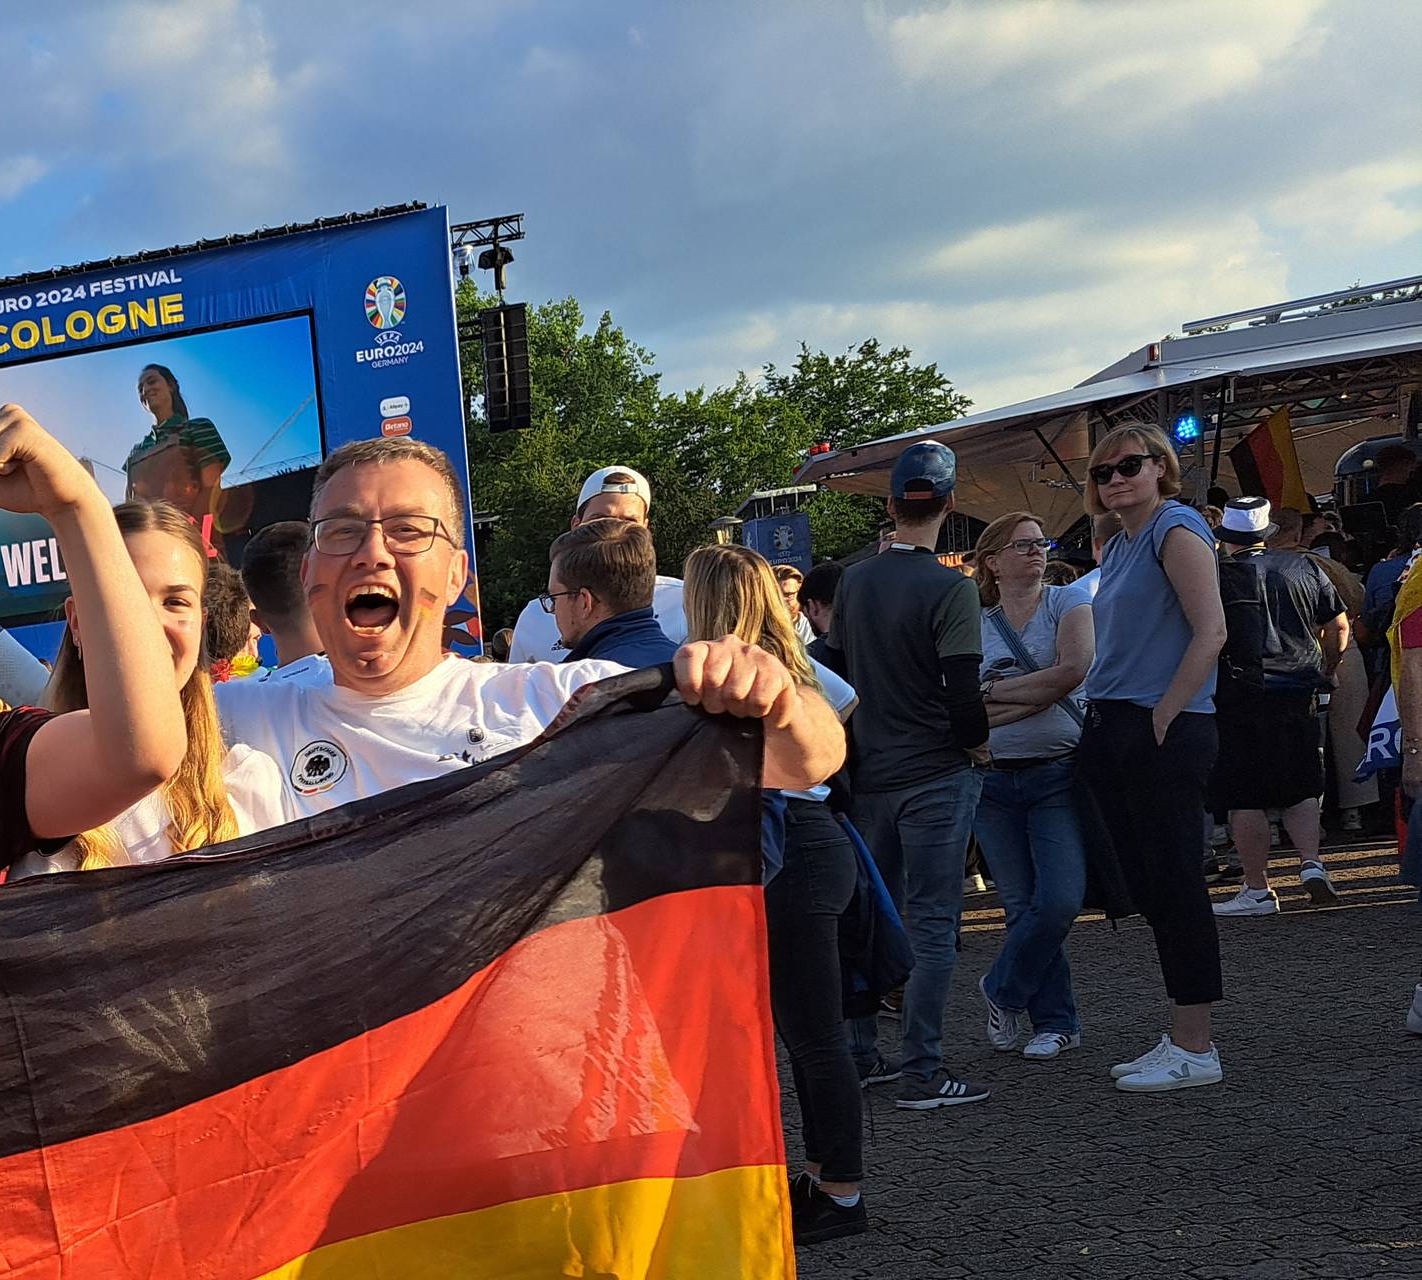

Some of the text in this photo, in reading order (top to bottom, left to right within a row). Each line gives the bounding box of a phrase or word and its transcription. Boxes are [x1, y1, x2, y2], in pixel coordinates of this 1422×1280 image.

[36, 284, 87, 307] 2024
[89, 269, 182, 297] FESTIVAL
[376, 332, 401, 344] UEFA
[355, 341, 424, 363] EURO2024
[371, 356, 409, 369] GERMANY
